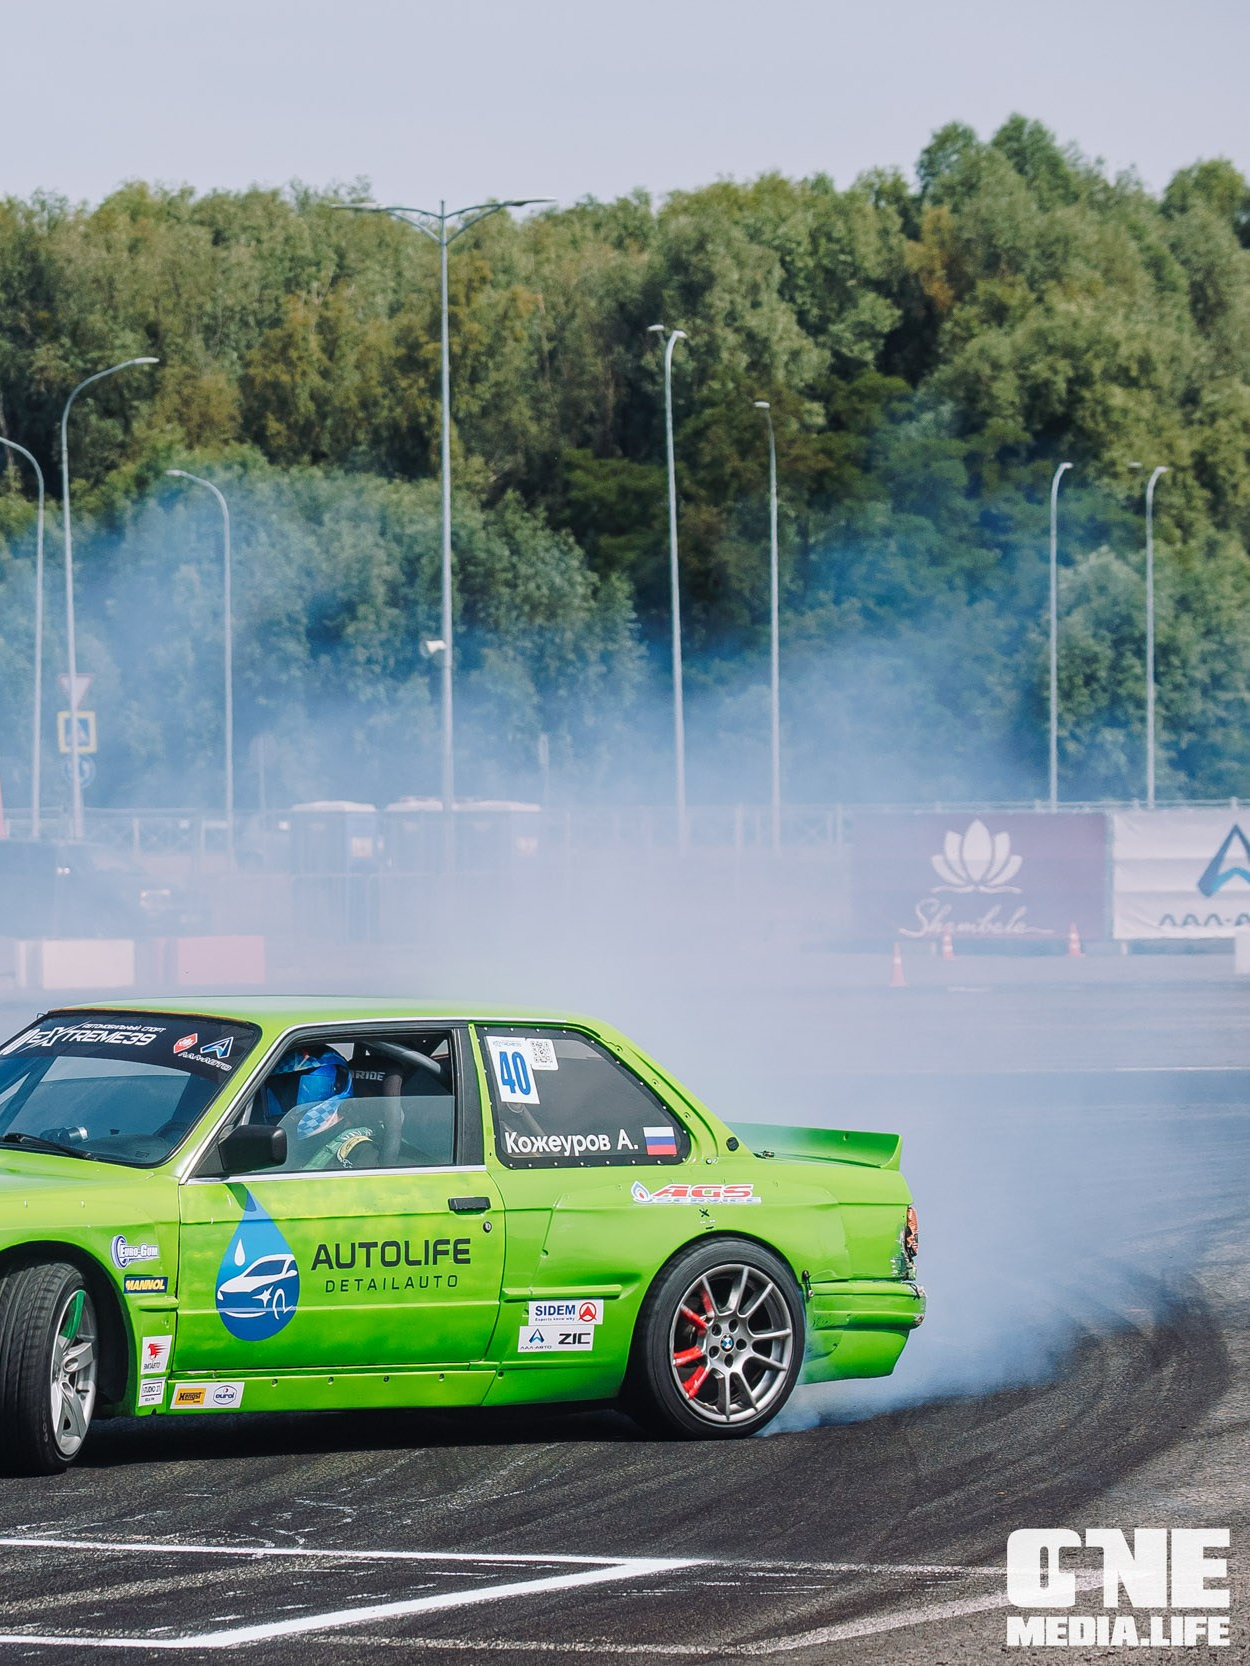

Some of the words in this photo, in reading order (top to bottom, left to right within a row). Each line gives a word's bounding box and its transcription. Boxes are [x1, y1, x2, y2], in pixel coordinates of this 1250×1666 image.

[499, 1051, 531, 1095] 40
[504, 1131, 611, 1157] Кожеуров
[617, 1129, 639, 1150] А.
[652, 1184, 753, 1198] AGS
[311, 1238, 471, 1270] AUTOLIFE
[126, 1279, 165, 1290] MANNOL
[325, 1275, 458, 1293] DETAILAUTO
[535, 1305, 576, 1316] SIDEM
[558, 1333, 591, 1345] ZIC
